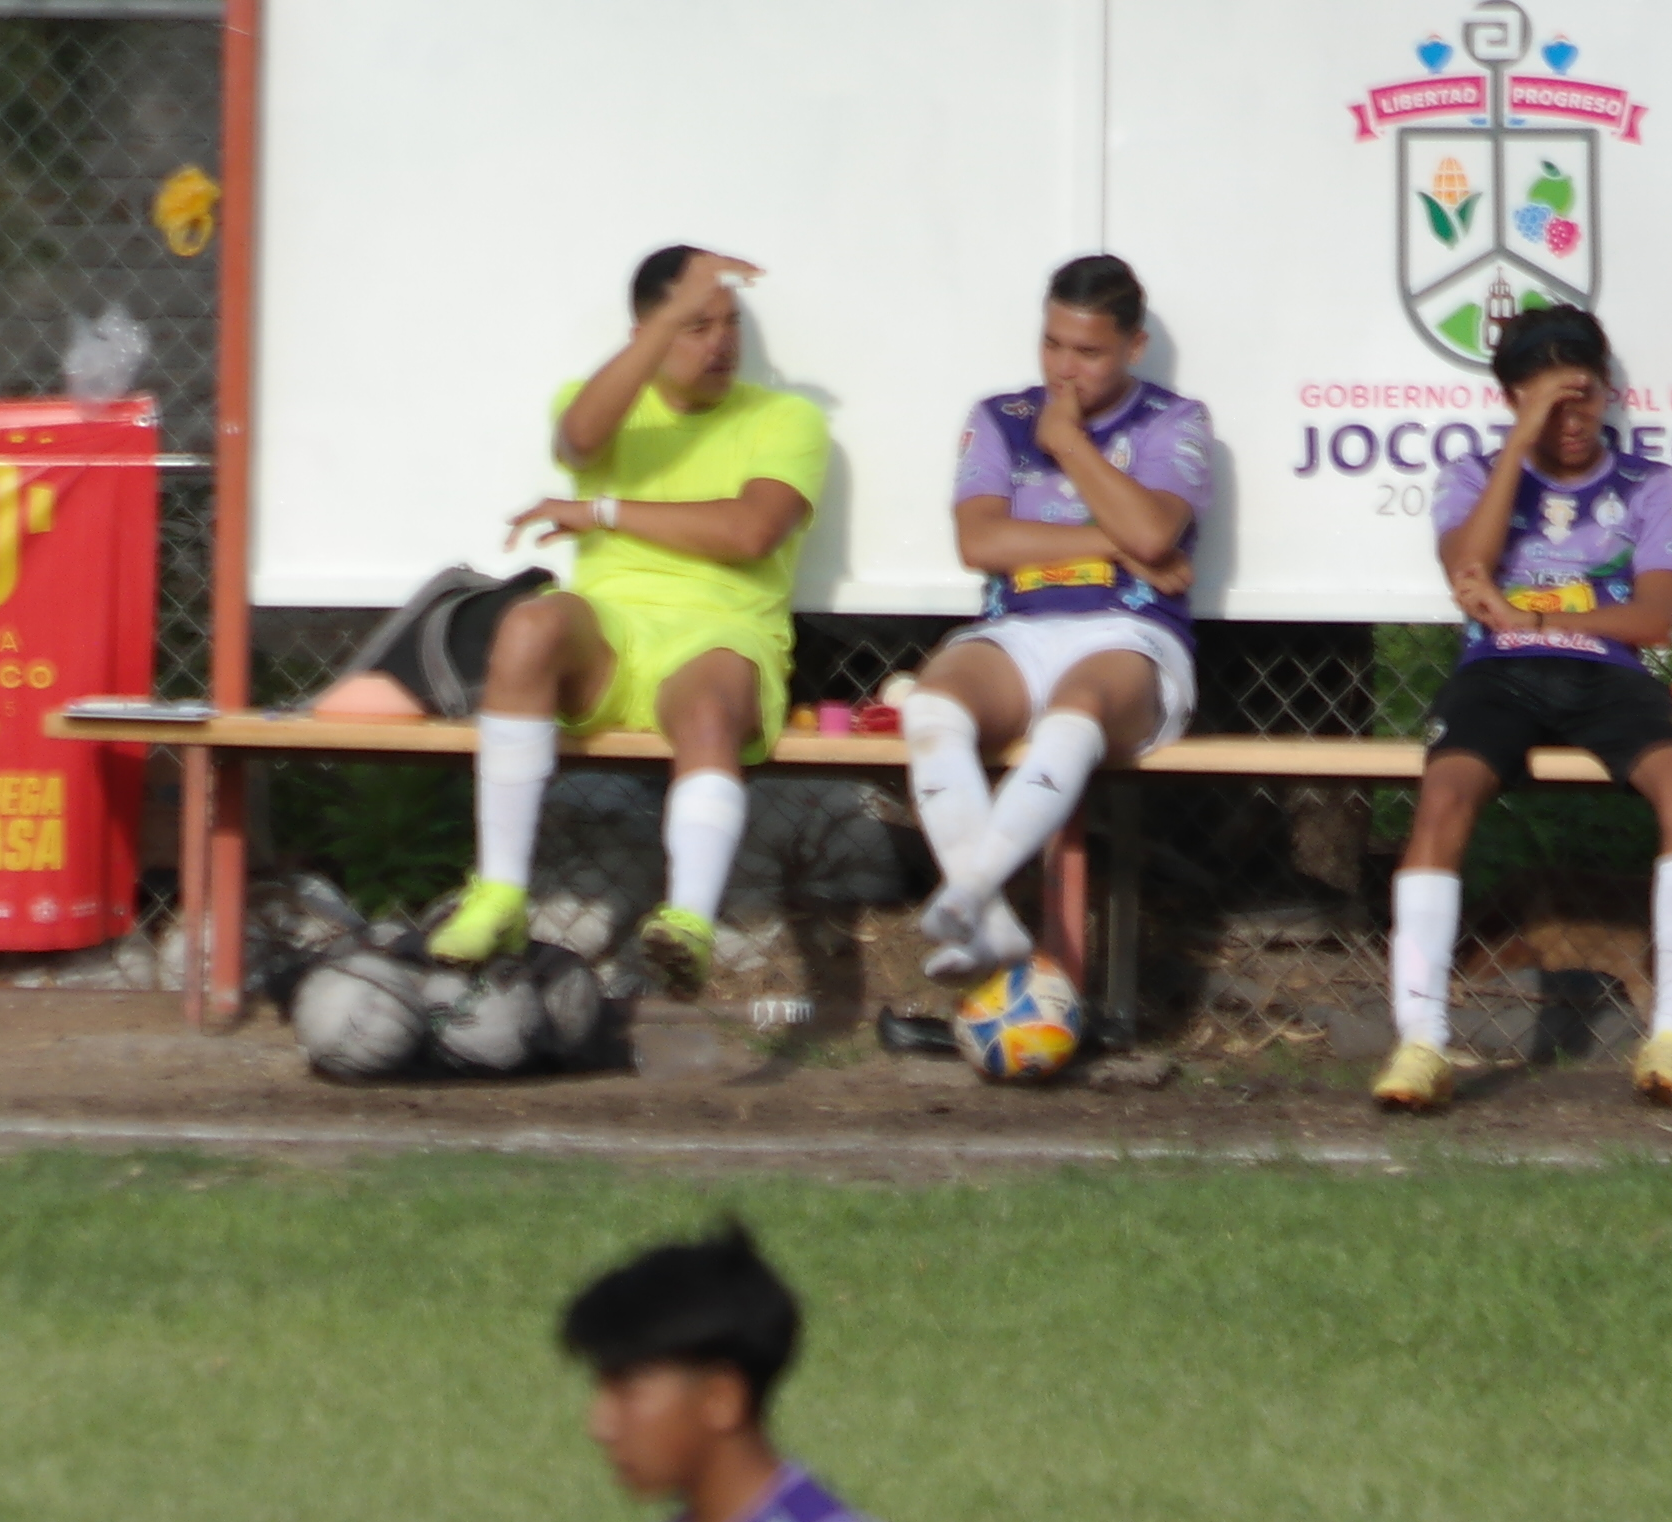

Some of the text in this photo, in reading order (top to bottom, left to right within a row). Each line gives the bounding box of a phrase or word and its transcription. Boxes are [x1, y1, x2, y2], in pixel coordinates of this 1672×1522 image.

[1381, 88, 1478, 114] LIBERTAD
[1512, 87, 1622, 117] PROGRESO
[1299, 384, 1471, 409] GOBIERNO
